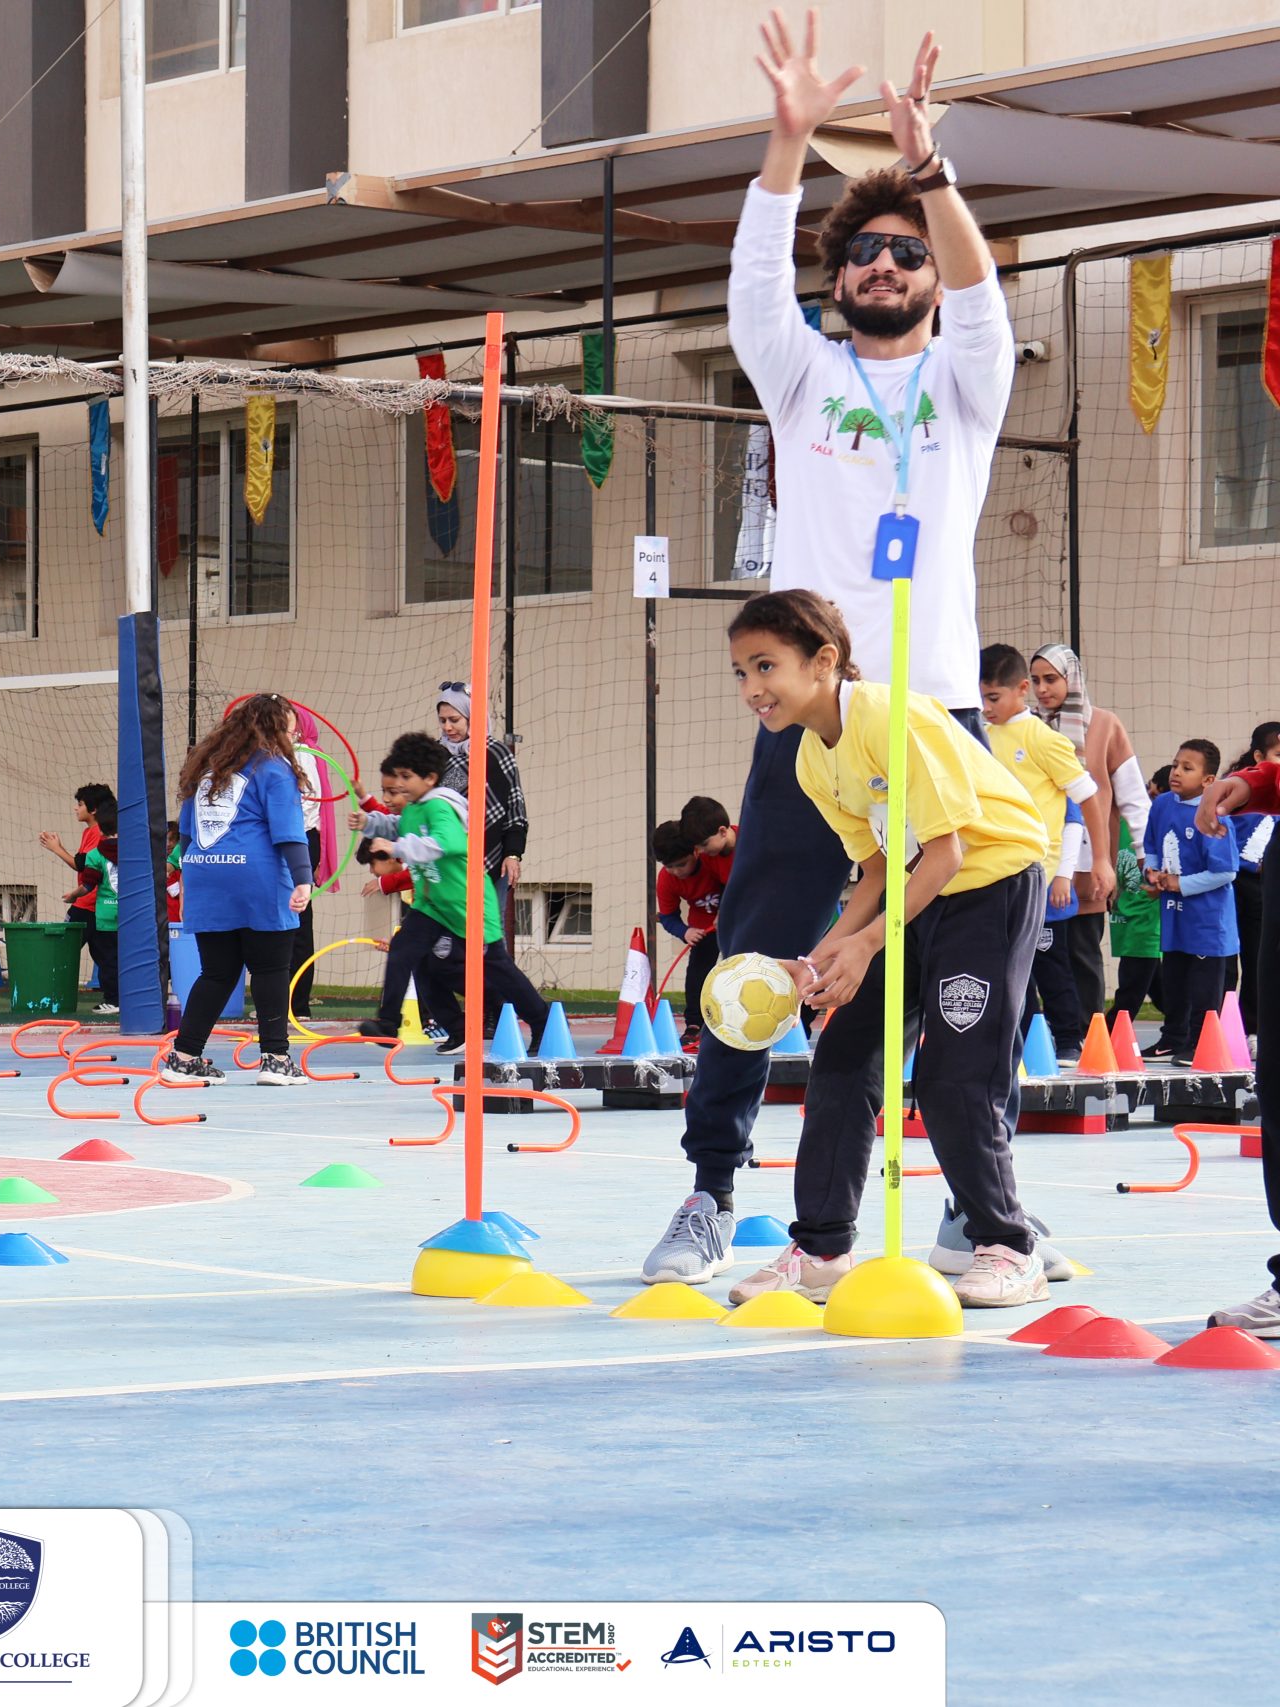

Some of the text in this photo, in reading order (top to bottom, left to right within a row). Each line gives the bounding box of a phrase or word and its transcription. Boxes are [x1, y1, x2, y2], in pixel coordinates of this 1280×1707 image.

[639, 551, 665, 563] Point
[649, 571, 657, 583] 4
[205, 854, 247, 864] COLLEGE
